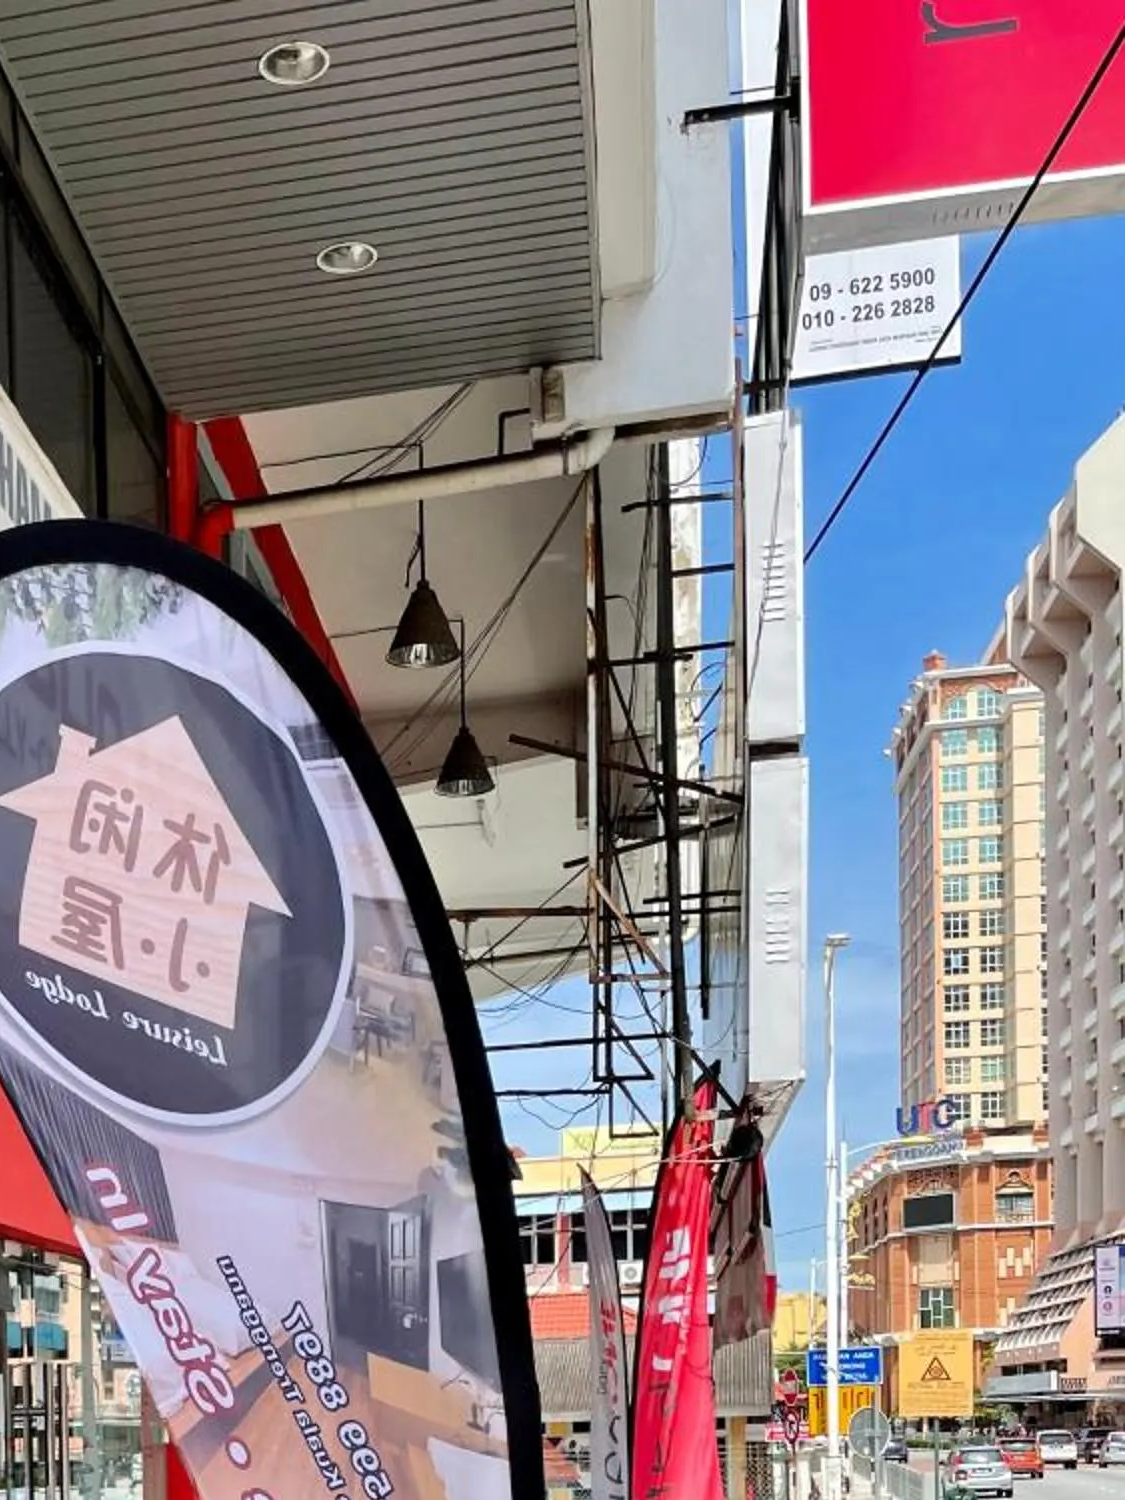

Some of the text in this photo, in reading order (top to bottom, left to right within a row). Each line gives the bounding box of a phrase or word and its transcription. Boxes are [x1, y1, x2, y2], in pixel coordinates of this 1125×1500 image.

[810, 282, 832, 301] 09
[850, 275, 883, 295] 622
[890, 267, 935, 290] 5900
[802, 310, 834, 330] 010
[852, 302, 885, 323] 226
[891, 295, 935, 317] 2828
[896, 1100, 957, 1136] UTC
